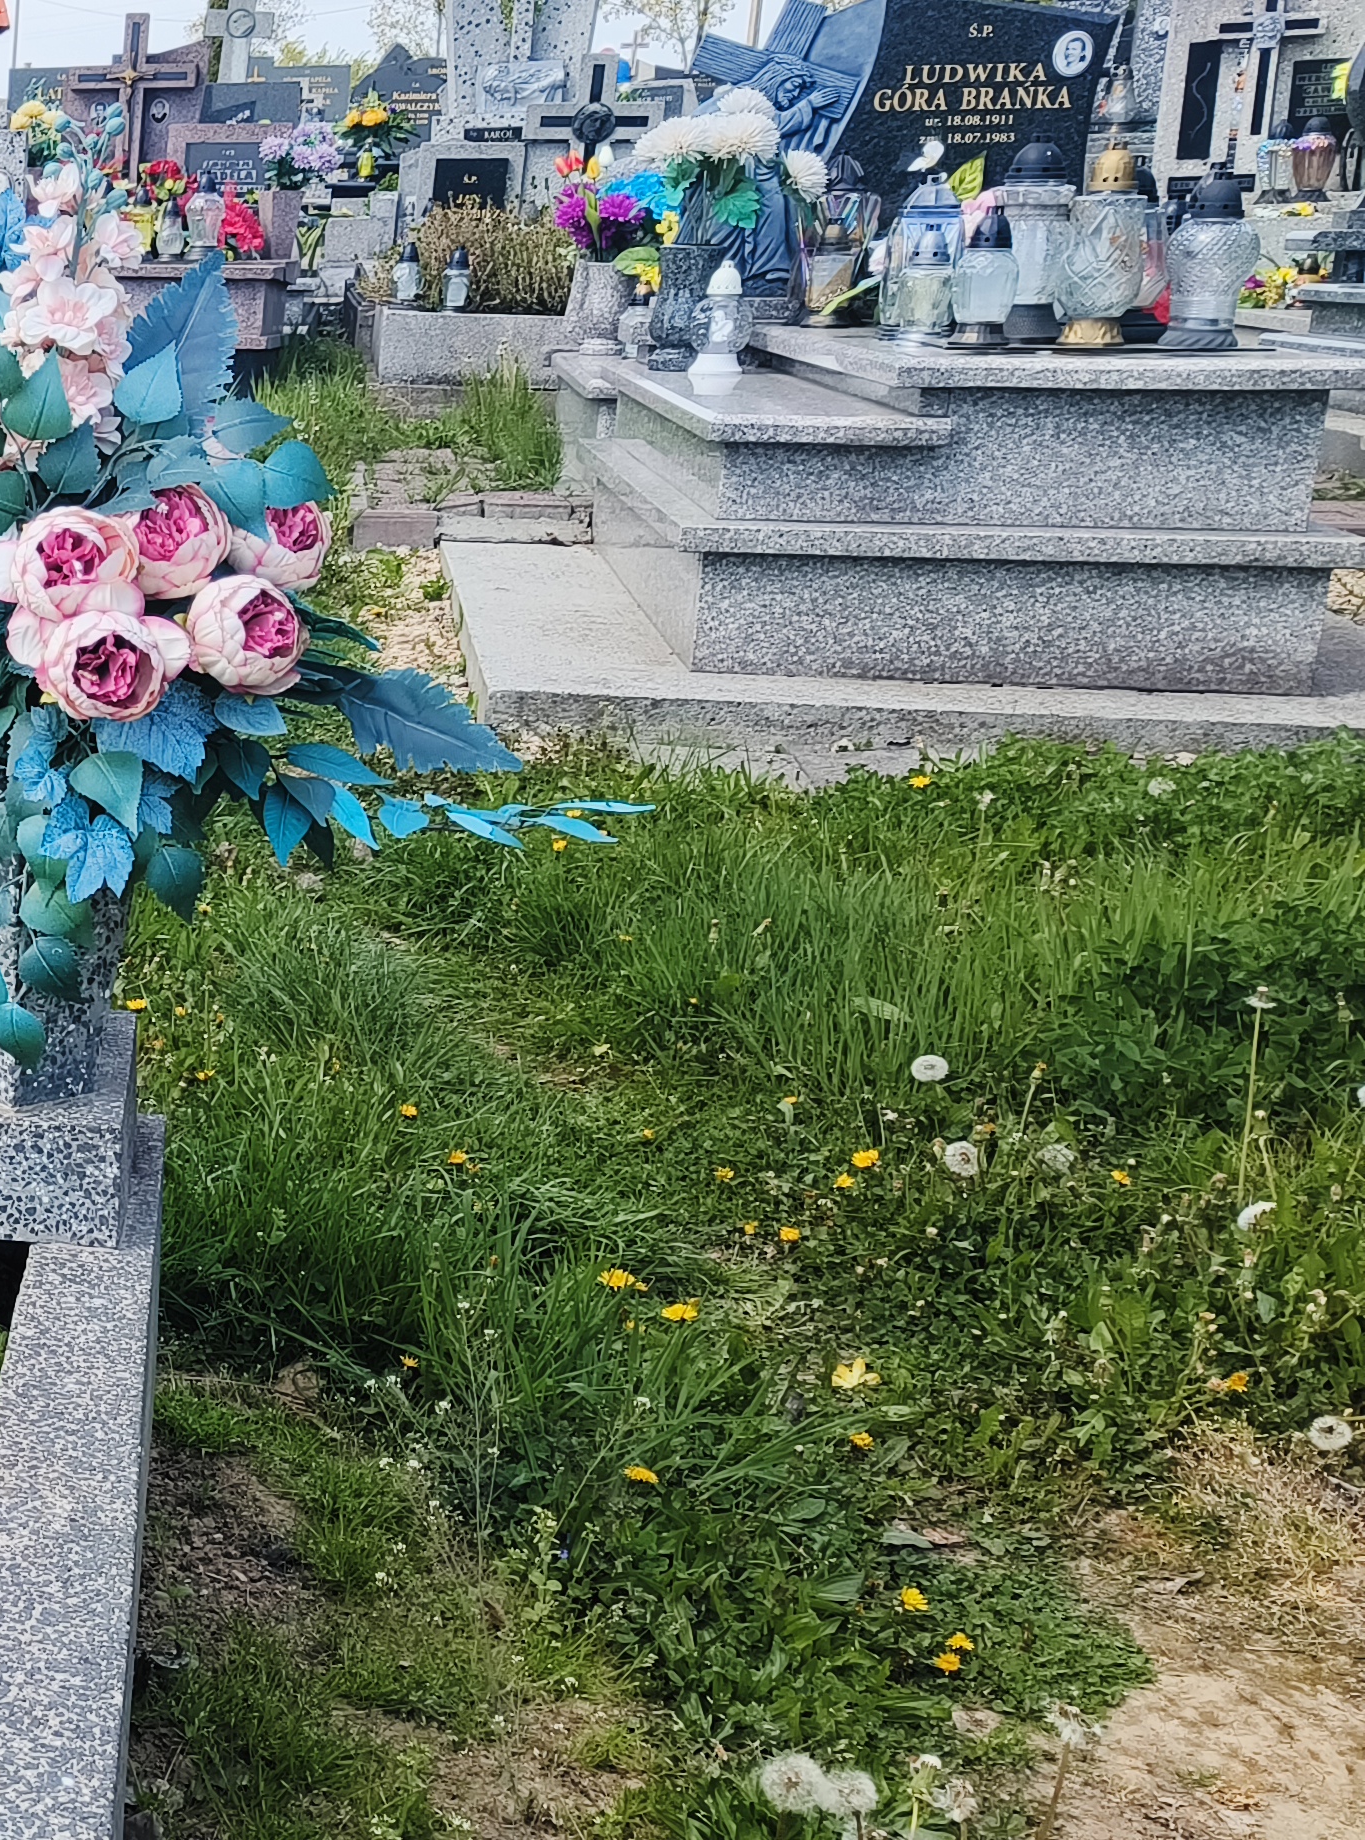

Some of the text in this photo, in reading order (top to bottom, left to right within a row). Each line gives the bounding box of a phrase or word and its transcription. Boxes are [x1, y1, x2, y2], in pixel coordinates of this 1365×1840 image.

[969, 23, 994, 38] Ś.P.
[903, 63, 1047, 84] LUDWIKA
[873, 81, 1072, 112] GÓRA BRAŃKA
[946, 115, 1014, 126] 18.08.1911
[947, 132, 1016, 144] 18.07.1983
